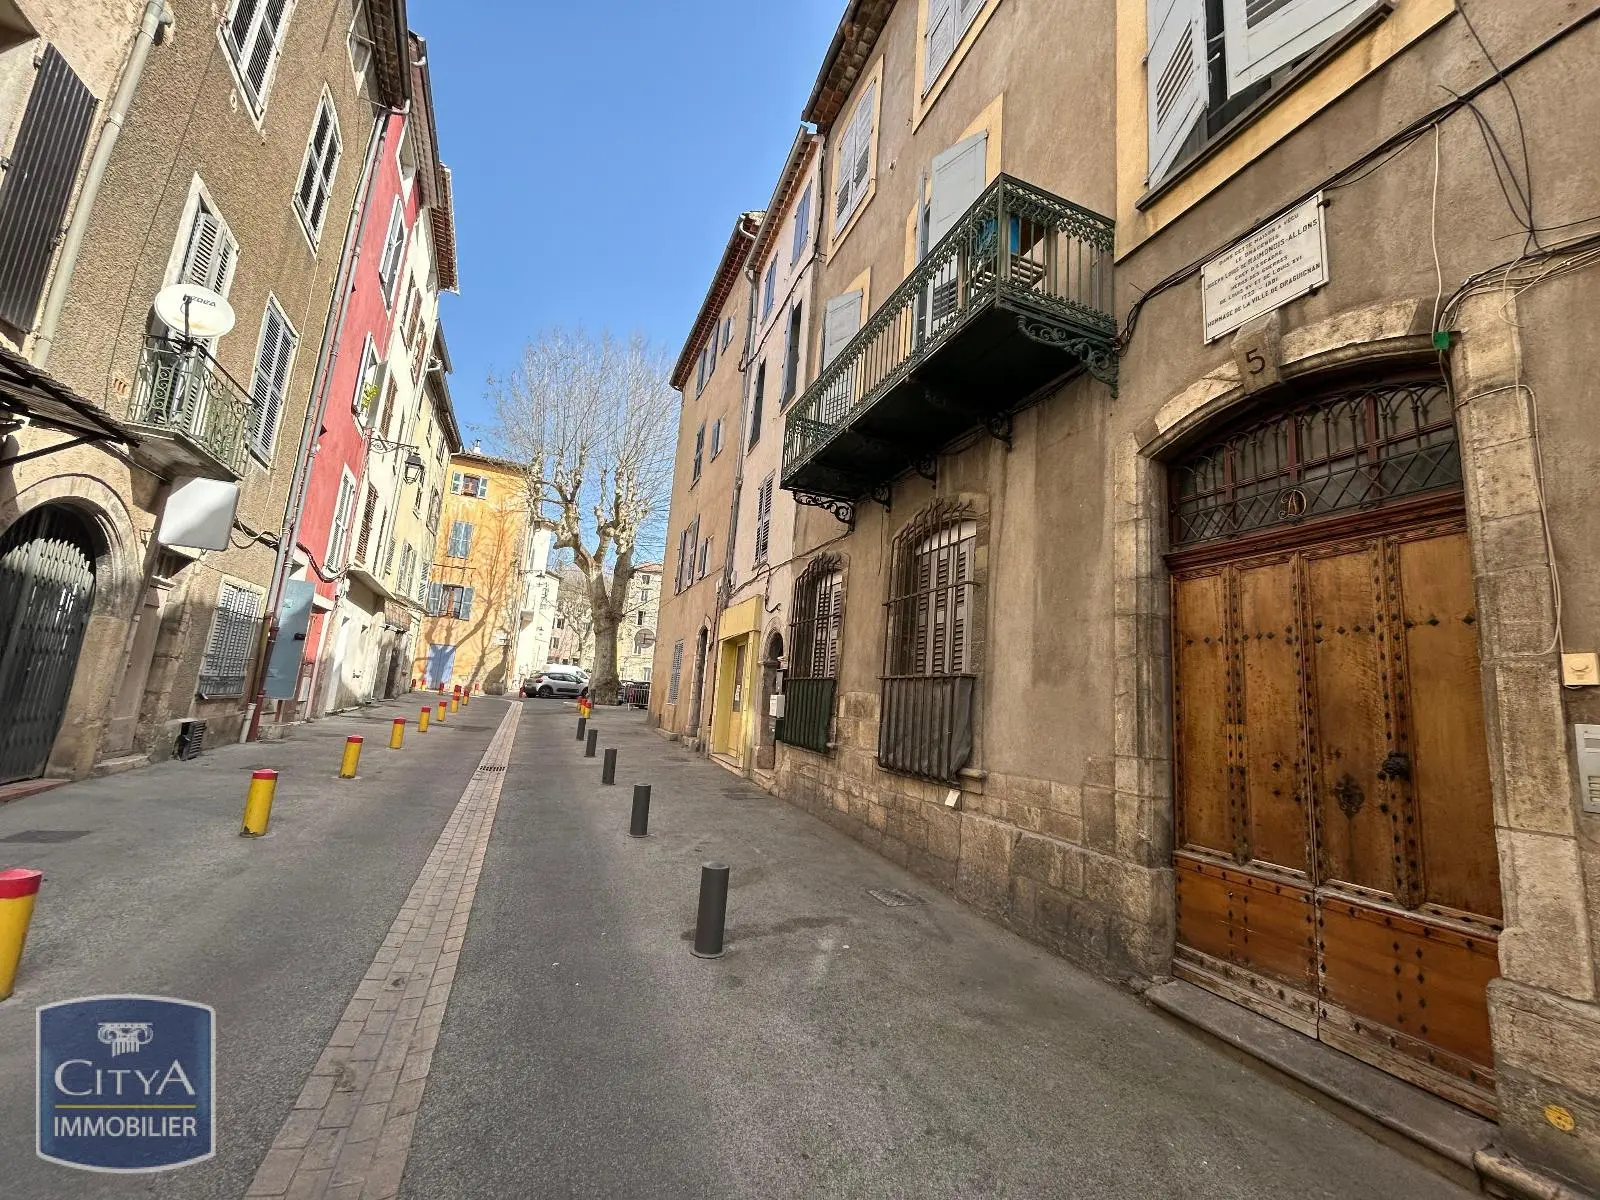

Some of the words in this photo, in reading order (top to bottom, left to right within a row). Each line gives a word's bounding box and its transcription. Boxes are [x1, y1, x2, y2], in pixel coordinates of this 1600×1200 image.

[1207, 309, 1232, 328] HOMMAGE
[1251, 289, 1268, 304] VILLE
[1279, 261, 1320, 289] DRAGUIGNAN
[1245, 348, 1266, 375] 5
